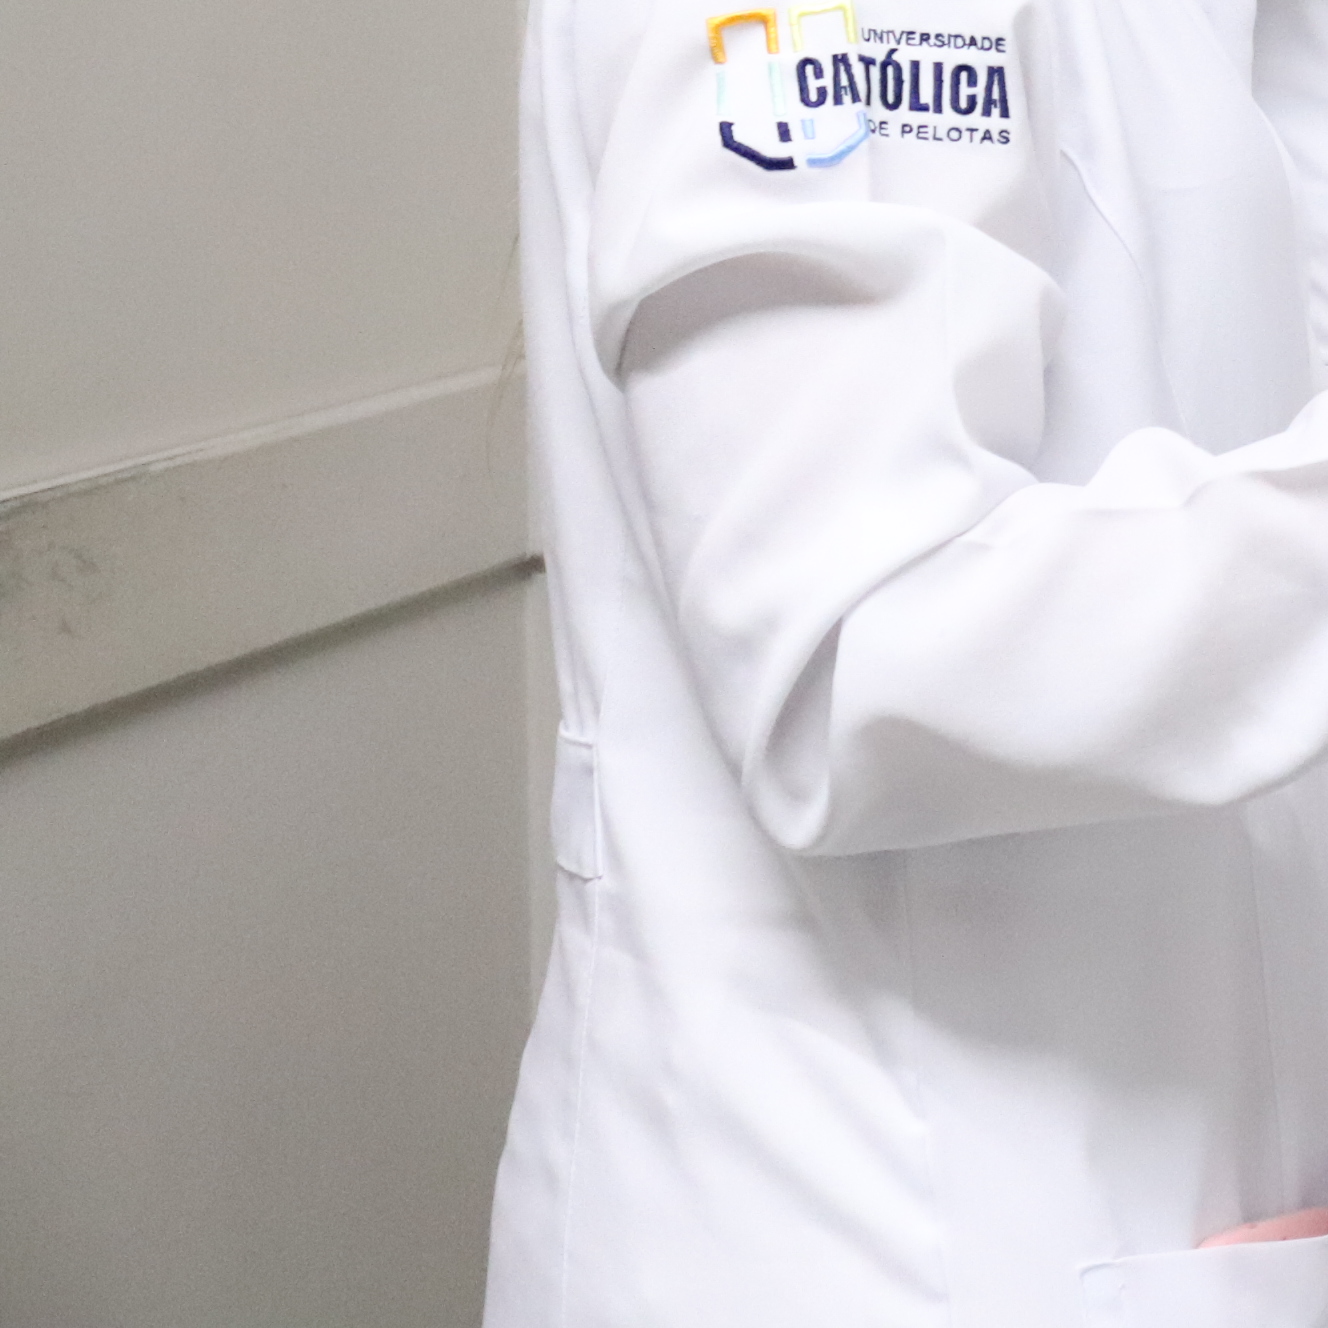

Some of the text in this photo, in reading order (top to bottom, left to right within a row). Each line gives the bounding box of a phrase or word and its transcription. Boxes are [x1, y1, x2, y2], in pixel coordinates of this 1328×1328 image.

[862, 27, 1006, 53] UNIVERSIDADE
[796, 48, 1010, 119] CATÓLICA
[867, 119, 1011, 145] DE PELOTAS
